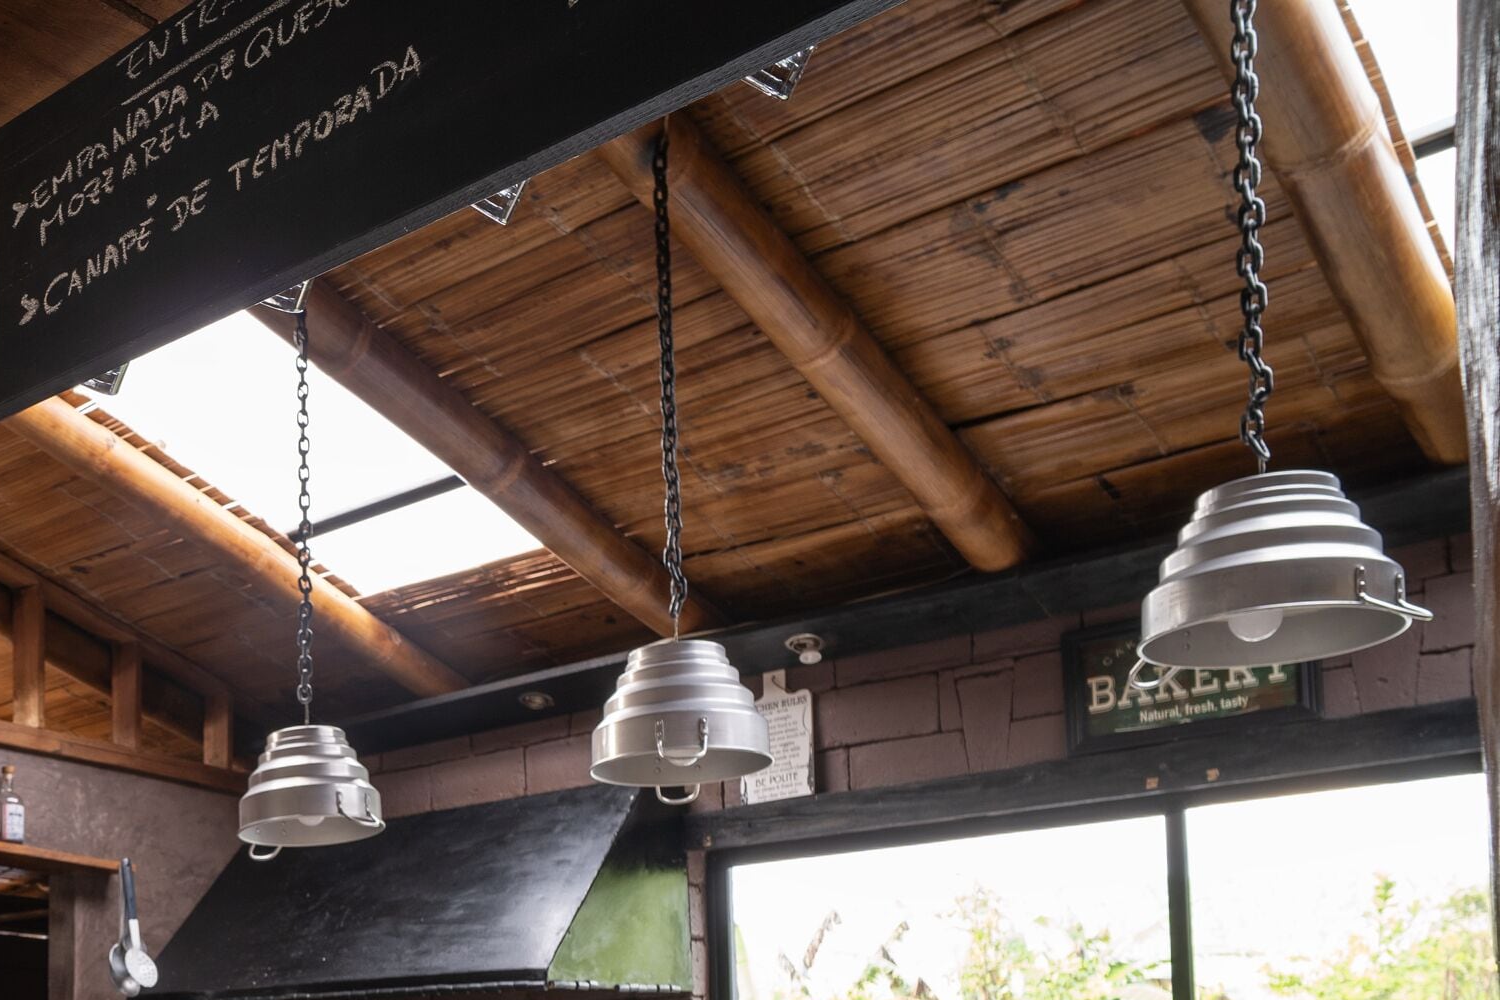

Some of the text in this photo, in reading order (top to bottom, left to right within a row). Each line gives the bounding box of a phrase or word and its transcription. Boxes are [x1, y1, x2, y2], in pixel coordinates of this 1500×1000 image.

[30, 84, 190, 211] EMPANADA
[193, 49, 236, 92] DE
[167, 179, 211, 232] DE
[228, 44, 422, 191] TEMPORADA
[1139, 704, 1183, 724] Natural,
[1220, 695, 1250, 711] tasty
